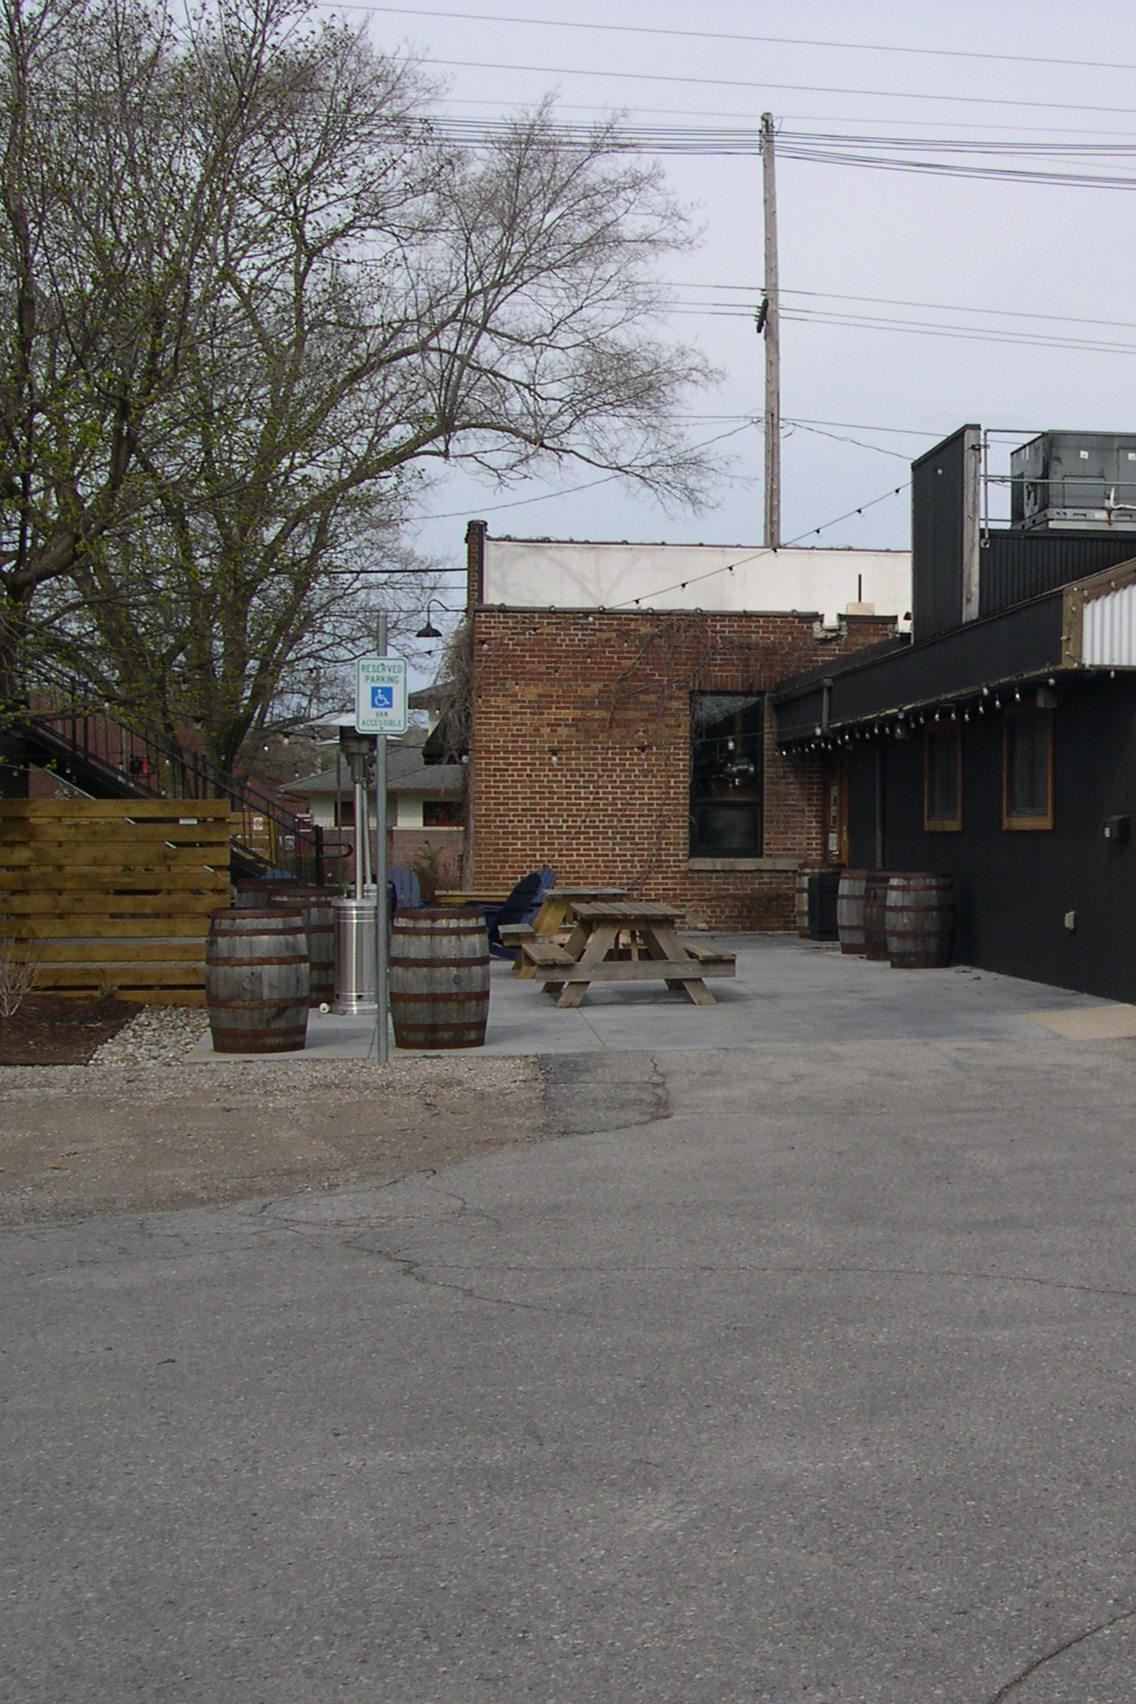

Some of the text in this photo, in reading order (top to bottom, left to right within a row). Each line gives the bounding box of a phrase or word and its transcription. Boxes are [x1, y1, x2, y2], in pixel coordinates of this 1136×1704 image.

[361, 664, 403, 674] RESERVED
[365, 675, 400, 684] PARKING
[361, 720, 402, 728] ACCESSIBLE
